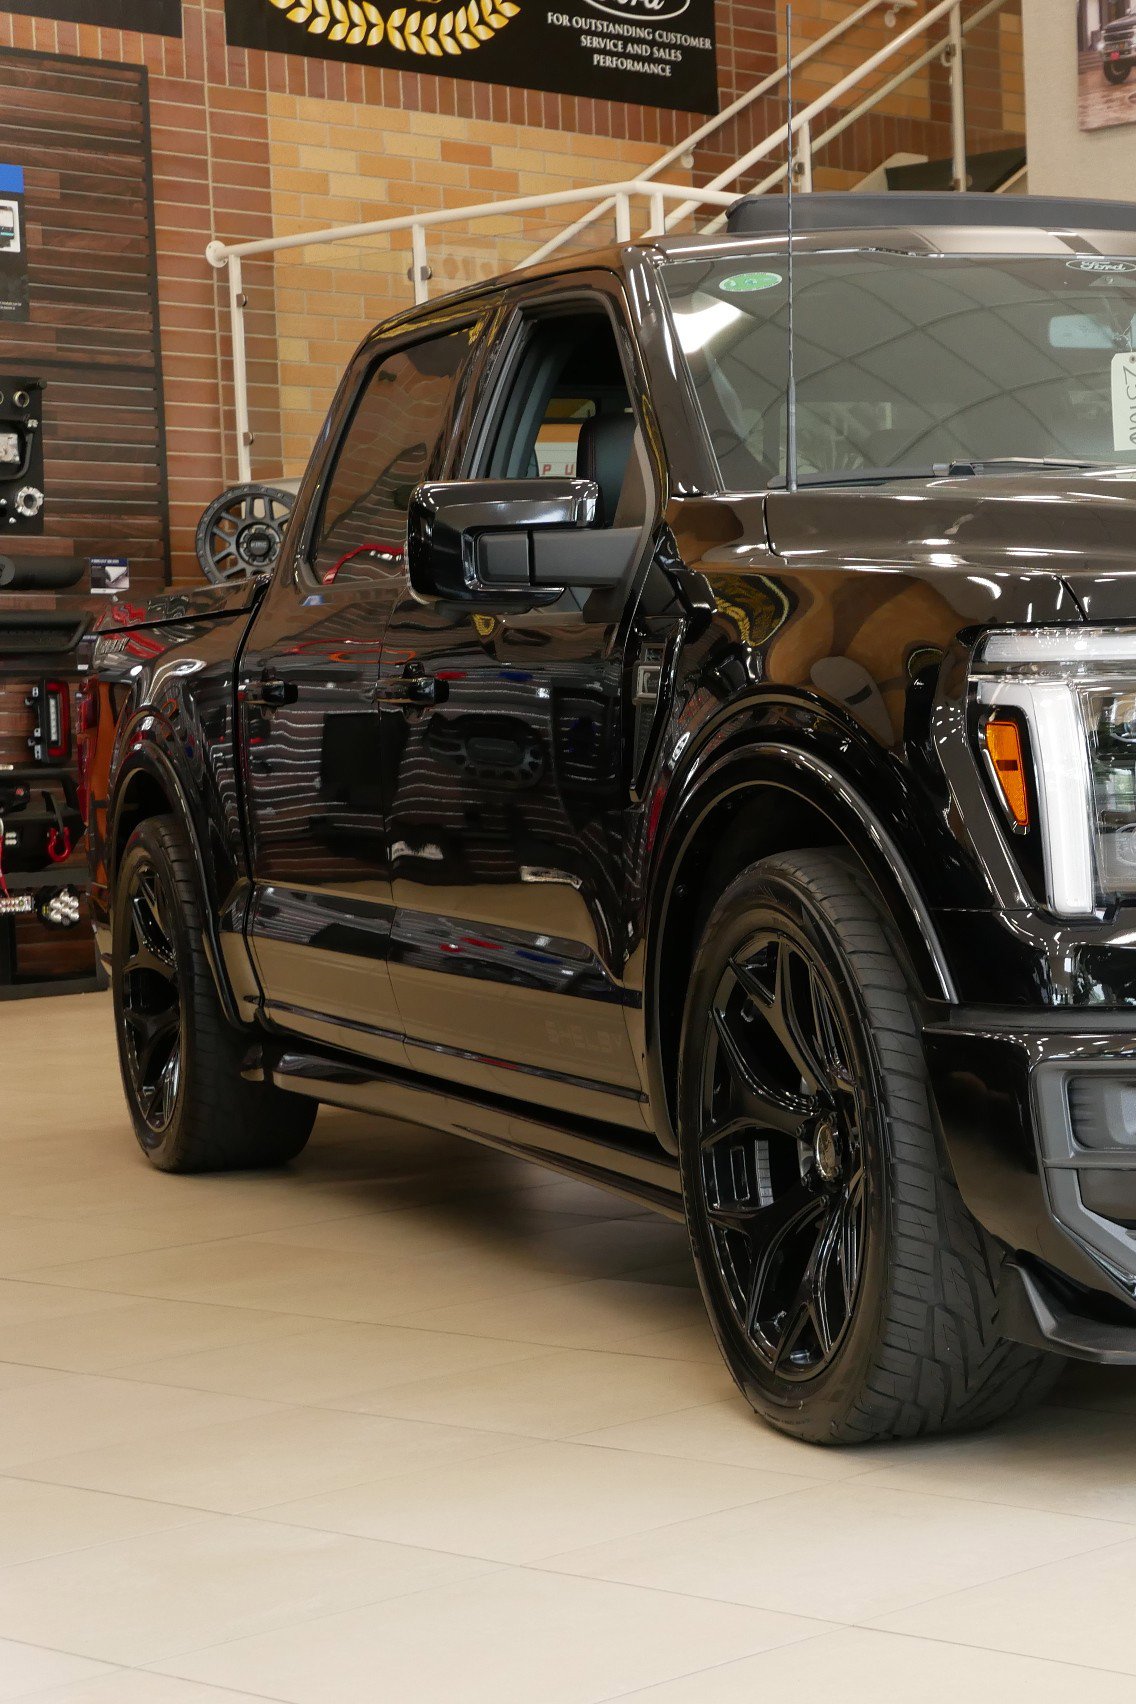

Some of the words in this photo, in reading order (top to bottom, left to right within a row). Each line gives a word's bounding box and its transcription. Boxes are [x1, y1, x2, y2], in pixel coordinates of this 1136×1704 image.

[547, 12, 571, 27] FOR
[572, 16, 653, 40] OUTSTANDING
[655, 30, 712, 50] CUSTOMER
[580, 34, 624, 53] SERVICE
[625, 43, 651, 57] AND
[653, 46, 682, 62] SALES
[592, 54, 672, 77] PERFORMANCE
[1080, 260, 1126, 271] Ford
